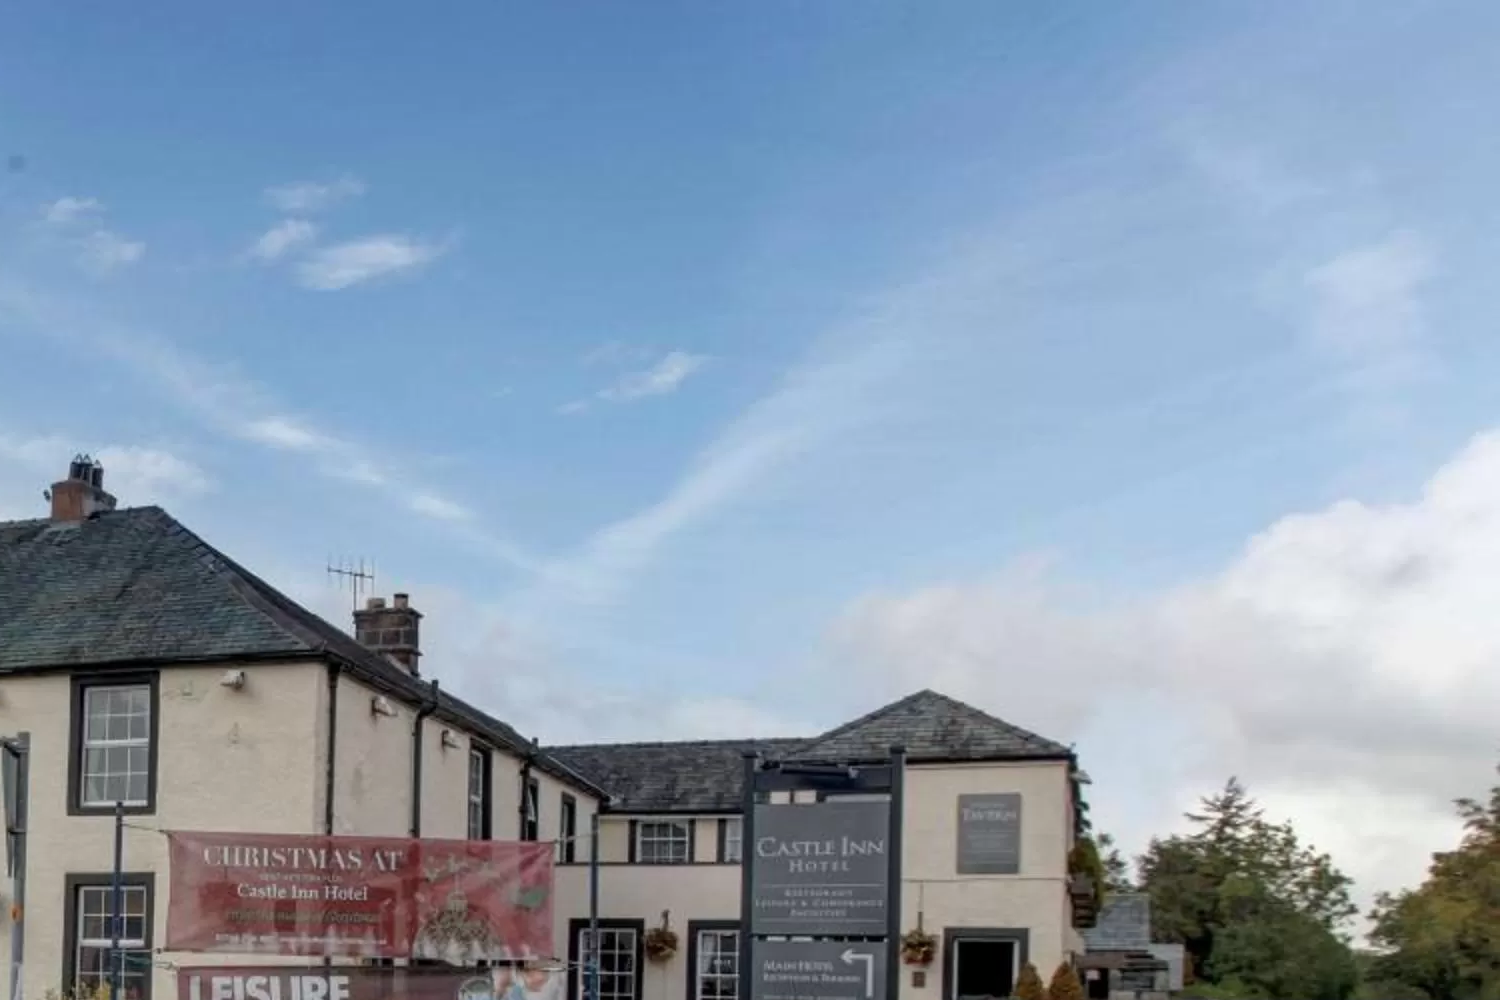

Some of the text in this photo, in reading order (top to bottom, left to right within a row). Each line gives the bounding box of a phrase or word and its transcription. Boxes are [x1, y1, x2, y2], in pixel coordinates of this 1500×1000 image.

[203, 844, 404, 872] CHRISTMAS AT
[788, 859, 851, 873] HOTEL
[236, 882, 369, 902] Castle Inn Hotel
